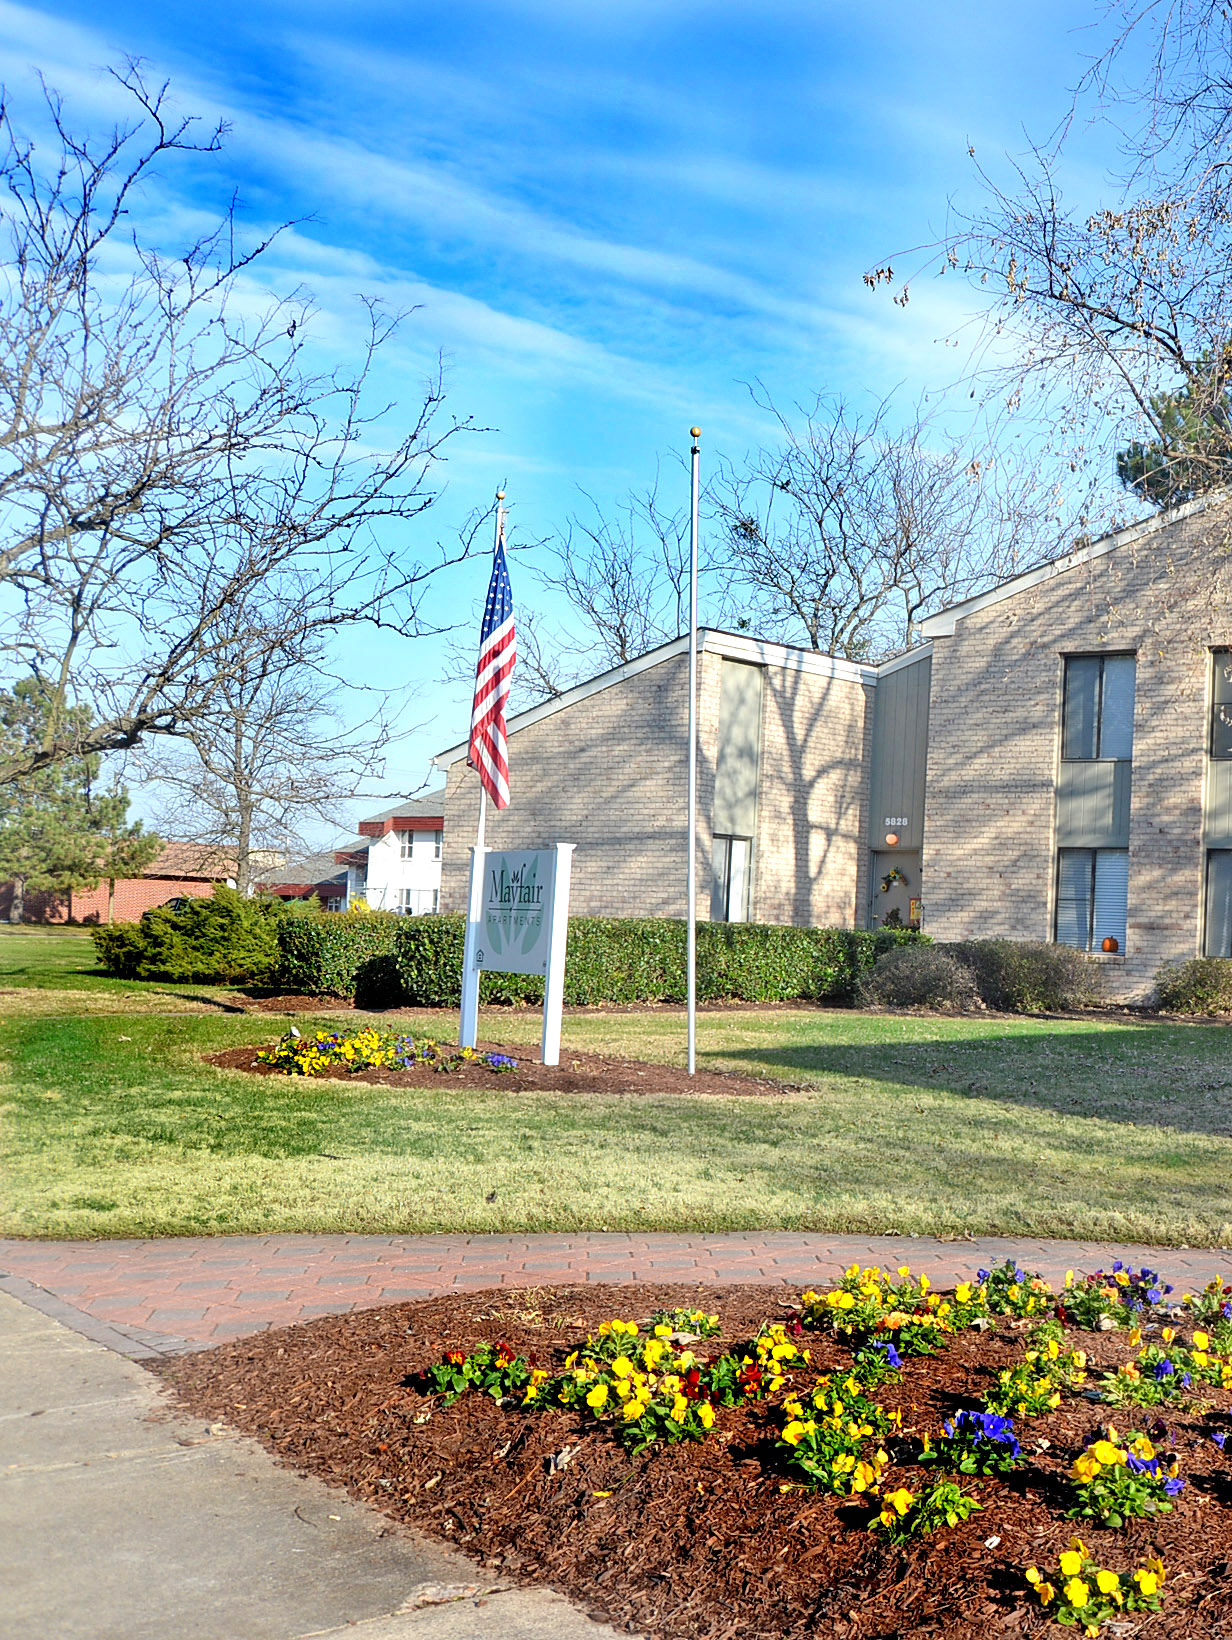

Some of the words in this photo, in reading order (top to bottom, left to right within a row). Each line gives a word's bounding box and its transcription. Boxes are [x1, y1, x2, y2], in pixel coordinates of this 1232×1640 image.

[885, 817, 908, 826] 5828
[488, 863, 543, 912] Mayfair
[487, 915, 541, 926] APARTMENTS
